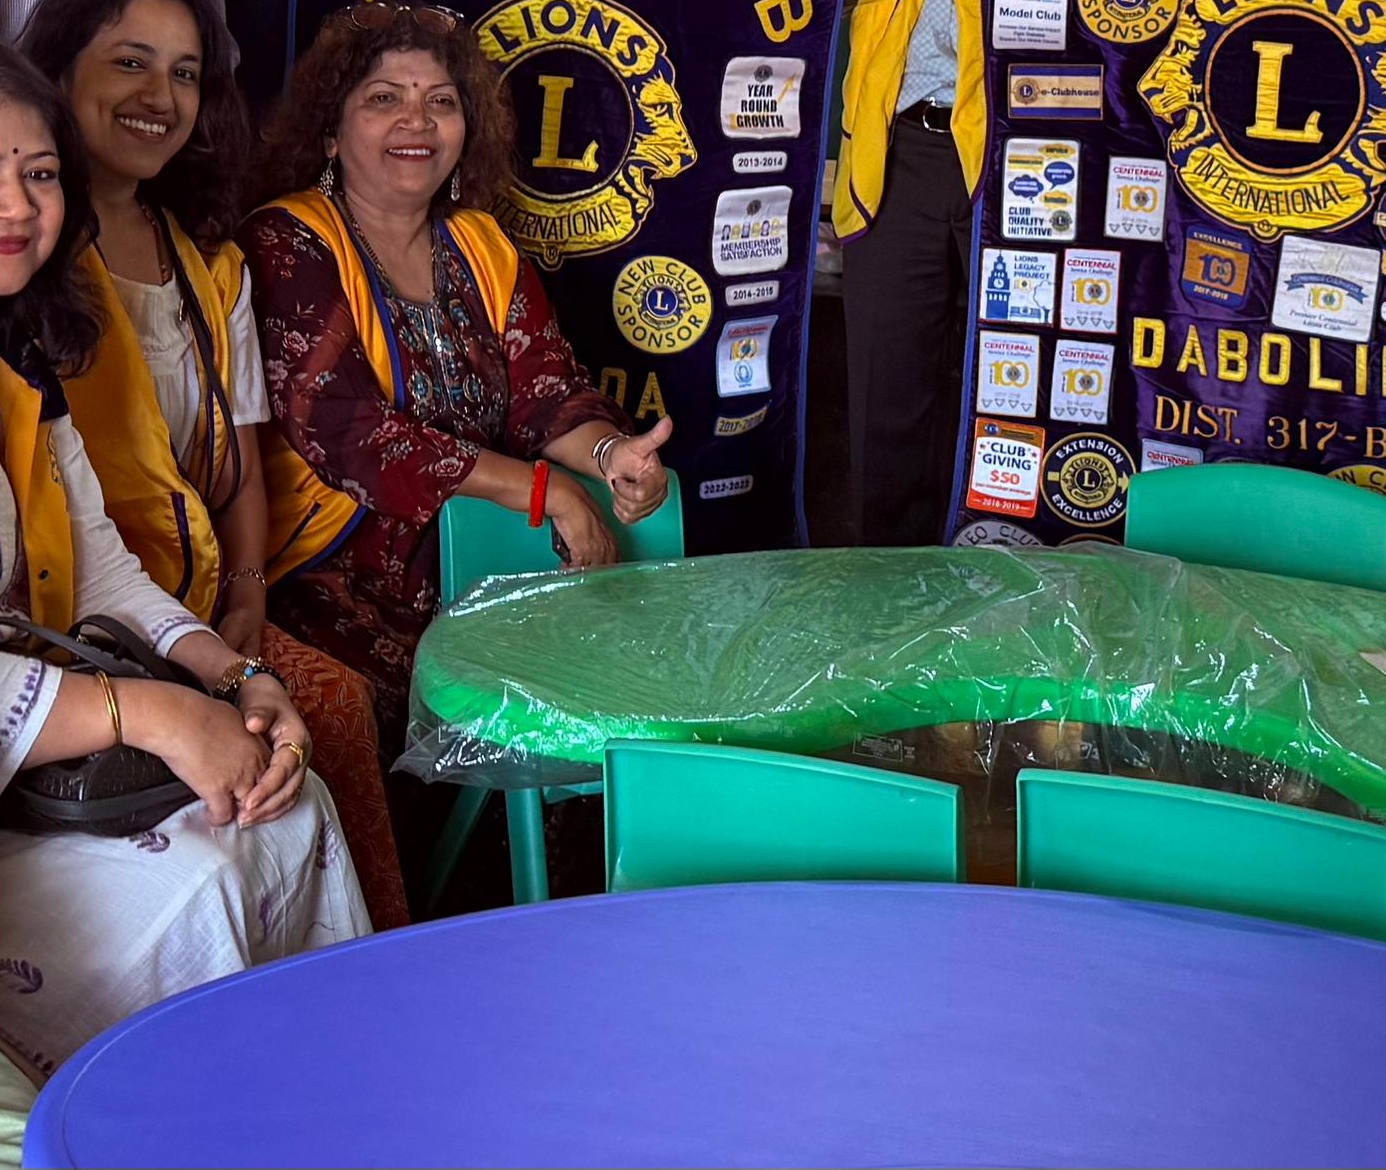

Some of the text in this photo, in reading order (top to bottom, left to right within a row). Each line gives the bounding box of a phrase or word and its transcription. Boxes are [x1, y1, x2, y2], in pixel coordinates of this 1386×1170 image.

[1000, 7, 1061, 22] Model Club
[748, 84, 773, 97] YEAR
[1041, 87, 1100, 96] e-Clubhouse
[1245, 40, 1325, 144] L
[741, 99, 778, 113] ROUND
[533, 74, 599, 174] L
[737, 114, 784, 128] GROWTH
[738, 157, 783, 168] 2013-2014
[1113, 166, 1164, 178] CENTENNIAL
[1193, 154, 1350, 215] INTERNATIONAL
[1121, 185, 1159, 213] 100
[1009, 207, 1031, 216] CLUB
[1009, 216, 1044, 227] QUALITY
[1008, 226, 1052, 236] INITIATIVE
[720, 238, 781, 252] MEMBERSHIP
[720, 247, 783, 262] SATISFACTION
[1014, 255, 1038, 264] LIONS
[1014, 264, 1045, 272] LEGACY
[1066, 259, 1116, 270] CENTENNIAL
[1014, 271, 1050, 280] PROJECT
[618, 260, 708, 307] NEW CLUB
[1073, 278, 1111, 305] 100
[654, 290, 670, 312] L
[617, 304, 705, 349] SPONSOR
[984, 342, 1034, 353] CENTENNIAL
[1059, 349, 1110, 362] CENTENNIAL
[989, 360, 1030, 388] 100
[1063, 369, 1102, 396] 100
[1155, 396, 1242, 445] DIST.
[991, 442, 1026, 457] CLUB
[1055, 439, 1124, 464] EXTENSION
[982, 453, 1032, 471] GIVING
[990, 470, 1020, 485] $50
[1082, 470, 1096, 488] L
[982, 498, 1020, 511] 2018-2019
[1051, 494, 1123, 521] EXCELLENCE
